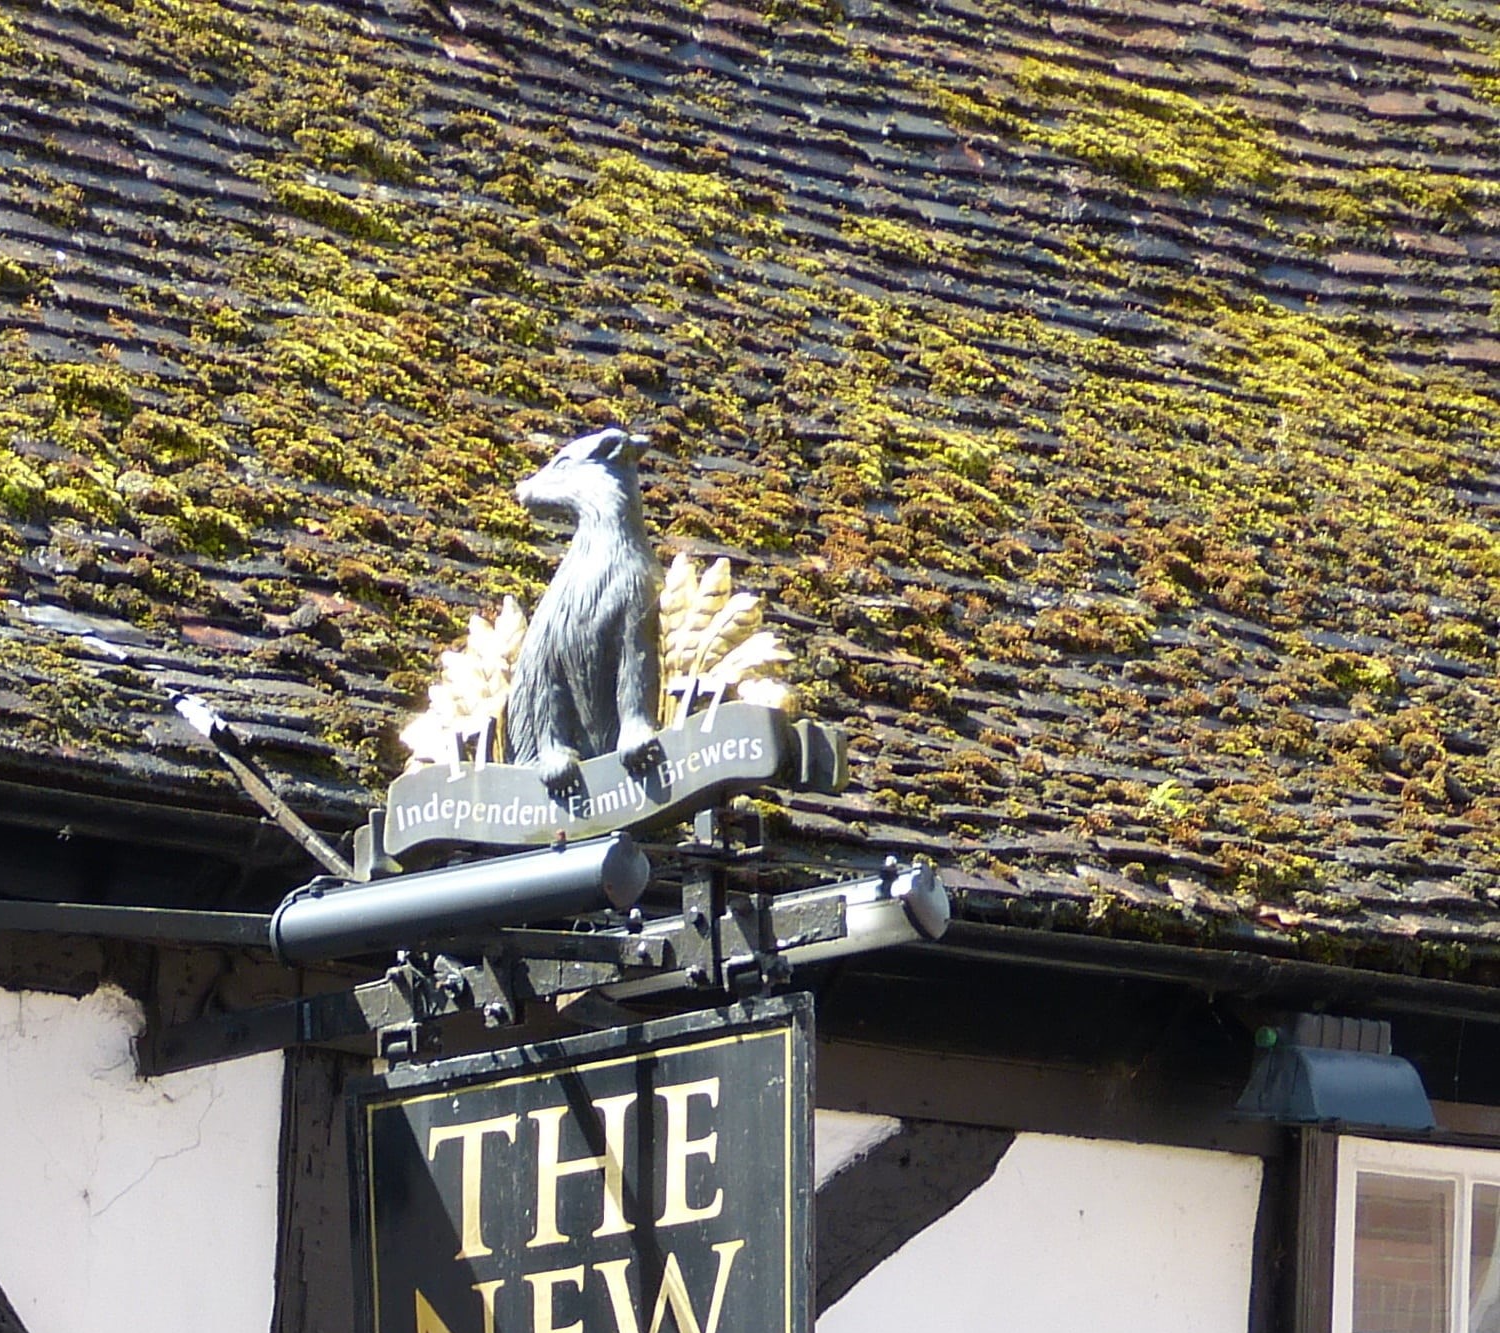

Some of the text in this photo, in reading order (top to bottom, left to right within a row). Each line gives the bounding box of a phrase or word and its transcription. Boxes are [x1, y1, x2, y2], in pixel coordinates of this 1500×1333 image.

[395, 735, 764, 832] Independent Family Brewers
[428, 1077, 725, 1260] THE
